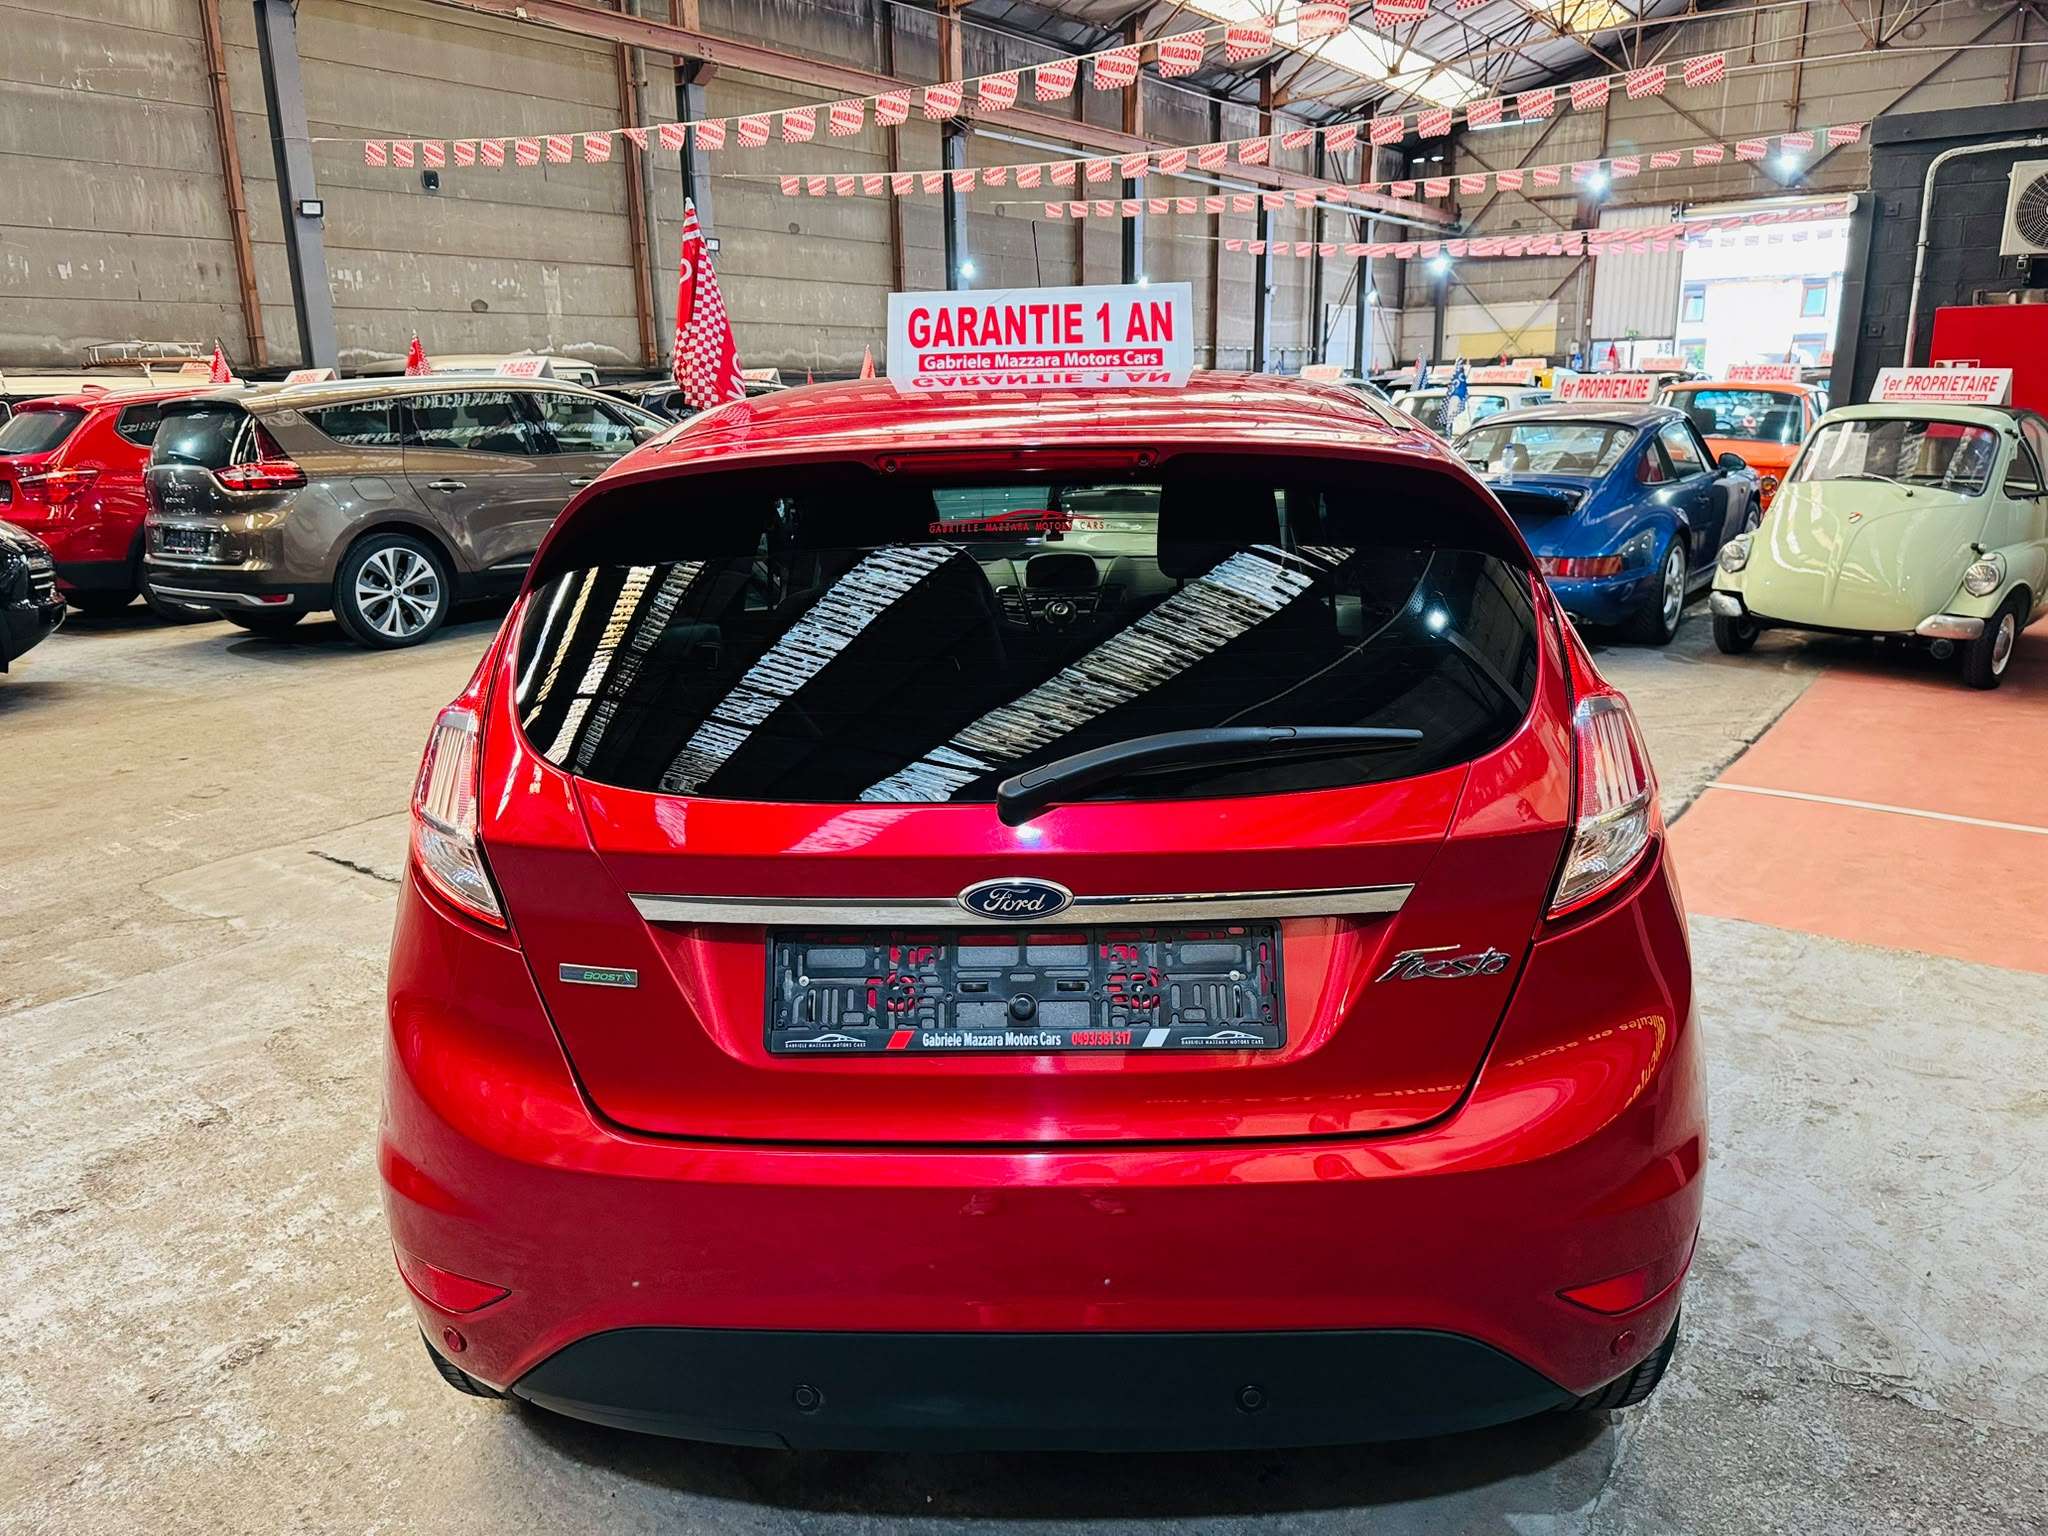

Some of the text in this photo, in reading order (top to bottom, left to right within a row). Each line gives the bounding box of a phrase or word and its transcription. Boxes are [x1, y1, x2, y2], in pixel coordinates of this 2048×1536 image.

[1685, 58, 1723, 81] OCCASION
[1628, 71, 1664, 93] OCCASION
[907, 301, 1173, 349] GARANTIE 1 AN
[924, 350, 1158, 371] Gabriele Mazzara Motors Cars
[1560, 378, 1650, 399] 1er PROPRIETAIRE
[1883, 375, 2000, 392] 1er PROPRIETAIRE
[929, 521, 979, 533] GABRIELE
[1080, 521, 1104, 530] CARS
[983, 888, 1046, 911] Ford
[1375, 944, 1512, 982] Fiesta
[922, 1032, 962, 1047] Gabriele
[963, 1032, 1003, 1047] Mazzara
[1005, 1031, 1039, 1046] Motors
[1040, 1031, 1062, 1046] Cars
